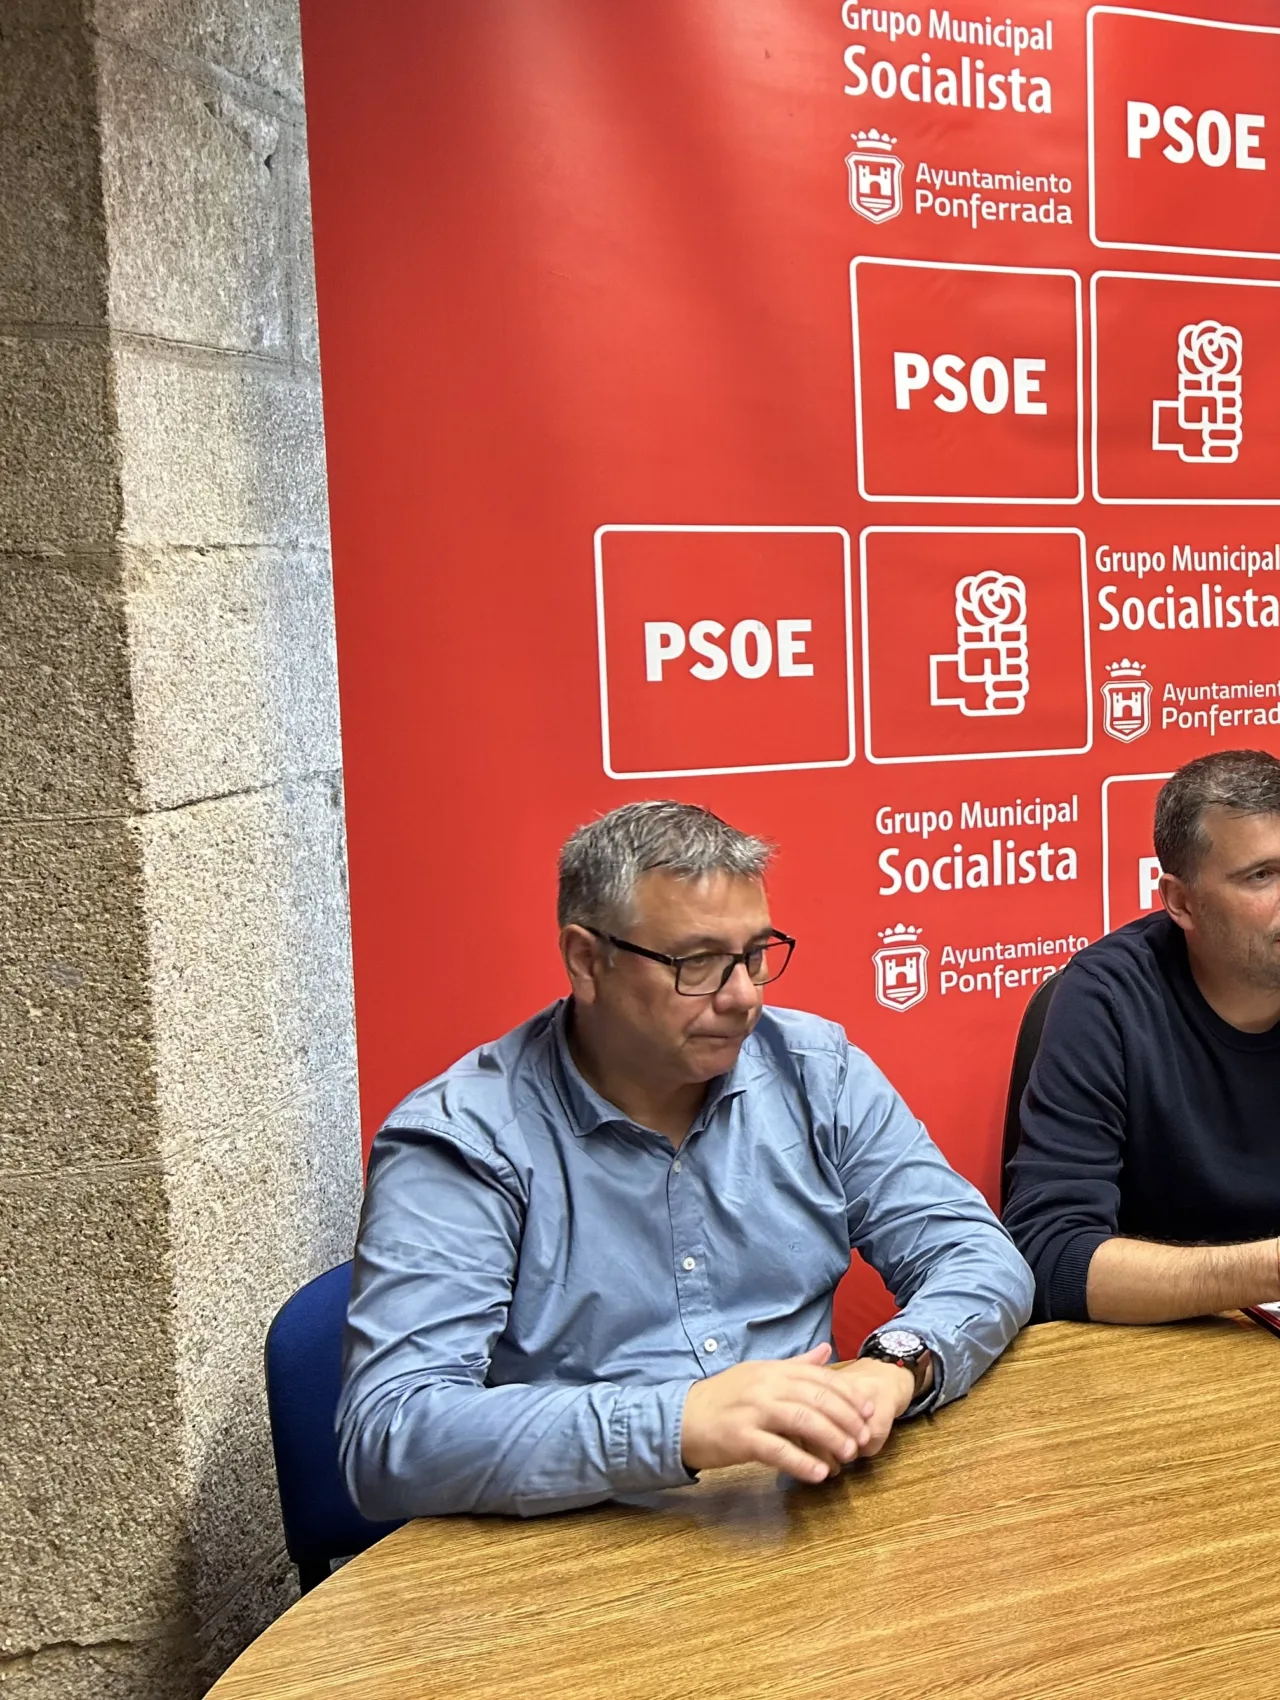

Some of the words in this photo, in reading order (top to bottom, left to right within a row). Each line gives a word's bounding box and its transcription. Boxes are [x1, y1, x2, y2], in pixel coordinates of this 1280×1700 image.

[841, 0, 922, 42] Grupo
[928, 8, 1053, 57] Municipal
[843, 44, 1053, 114] Socialista
[1126, 100, 1267, 171] PSOE
[915, 162, 1073, 196] Ayuntamiento
[915, 189, 1074, 230] Ponferrada
[893, 351, 1048, 416] PSOE
[1095, 546, 1166, 578] Grupo
[1172, 543, 1280, 578] Municipal
[1098, 582, 1280, 632] Socialista
[644, 618, 815, 683] PSOE
[875, 806, 954, 840] Grupo
[960, 794, 1079, 832] Municipal
[878, 838, 1078, 896] Socialista
[940, 934, 1089, 969] Ayuntamiento
[940, 957, 1072, 999] Ponferra
